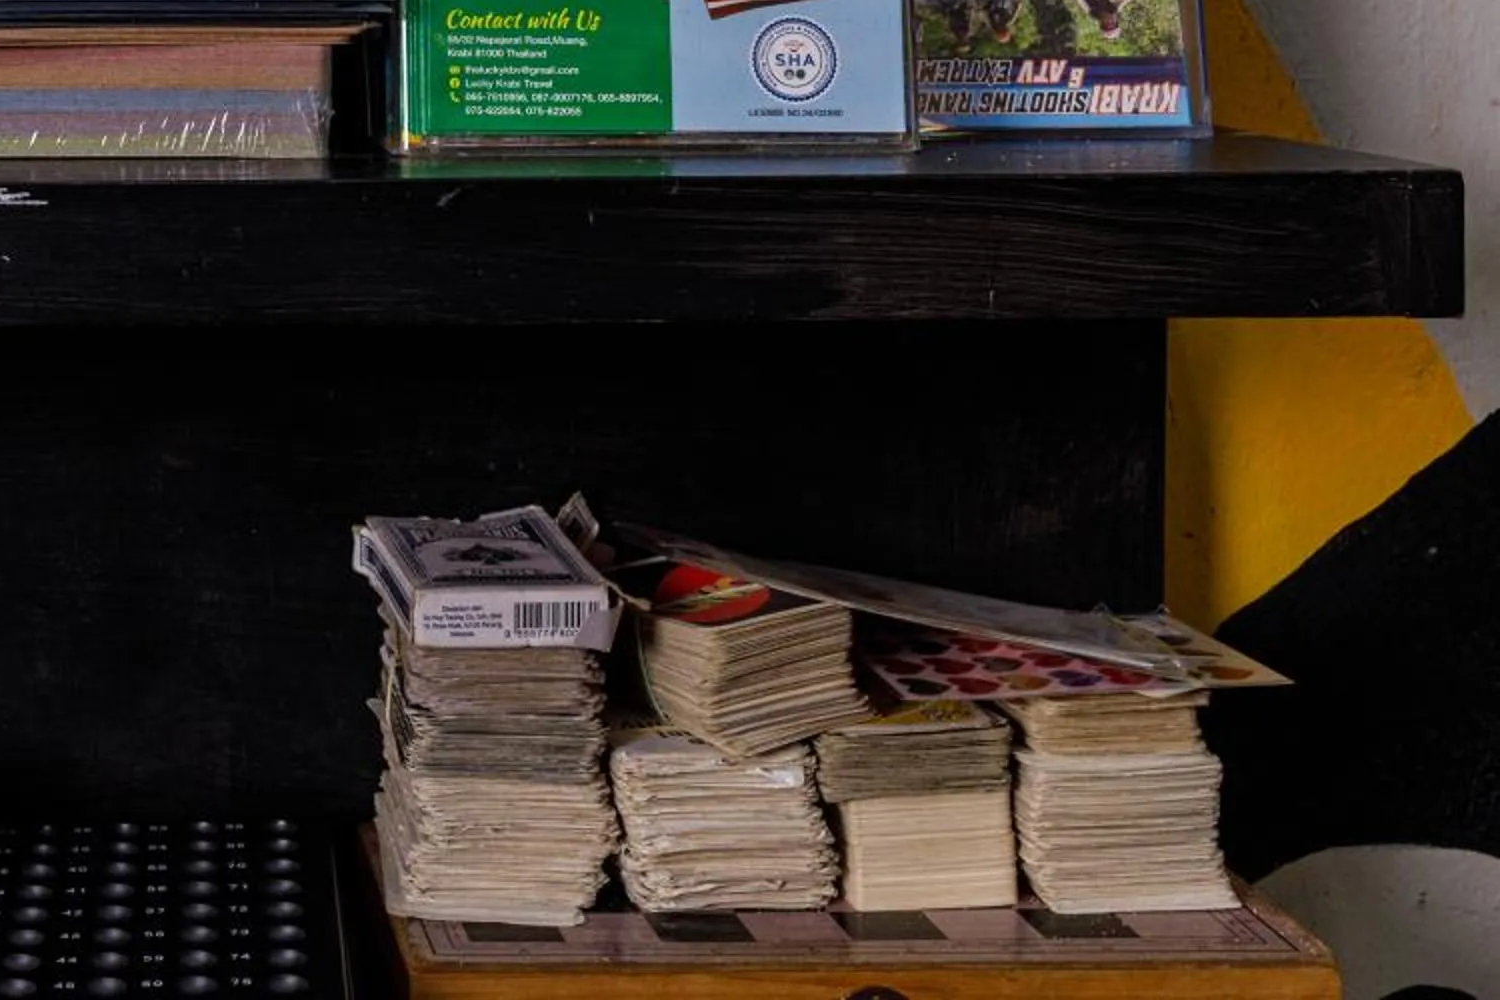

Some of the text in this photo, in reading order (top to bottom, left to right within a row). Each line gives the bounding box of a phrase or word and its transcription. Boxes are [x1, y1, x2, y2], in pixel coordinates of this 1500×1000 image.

[447, 8, 601, 31] Contact with Us
[507, 49, 547, 59] Thailand
[775, 53, 815, 66] SHA
[915, 58, 1012, 85] EXTREM
[1016, 59, 1067, 84] ATV
[917, 81, 1180, 116] KRABI SHOOTING RANG
